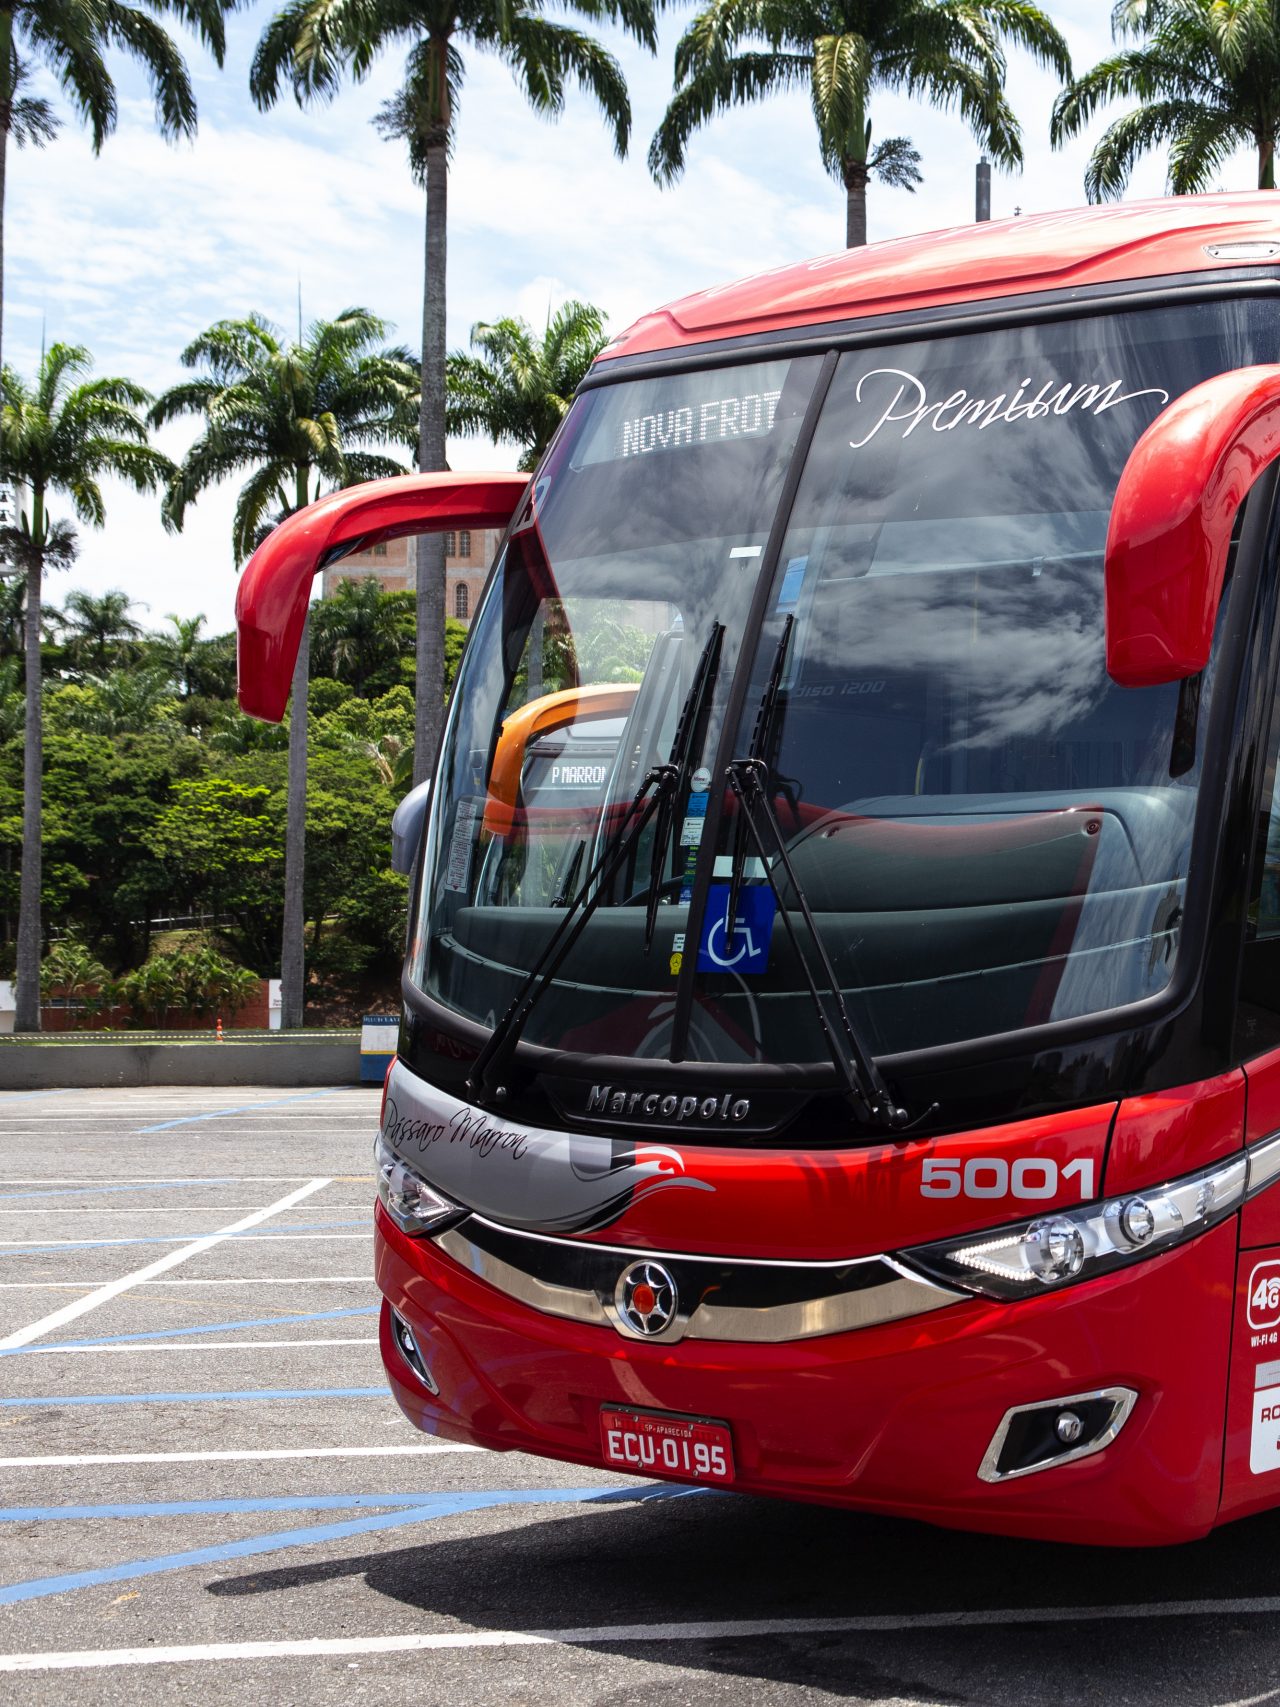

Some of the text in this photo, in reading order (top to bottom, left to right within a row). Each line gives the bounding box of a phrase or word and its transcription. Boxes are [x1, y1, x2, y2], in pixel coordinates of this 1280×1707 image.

[850, 368, 1168, 448] Premium
[623, 407, 692, 457] NOVA
[551, 766, 560, 784] P
[585, 1085, 750, 1121] Marcopolo
[384, 1097, 528, 1160] Pássaro Marron
[919, 1157, 1095, 1200] 5001
[1250, 1332, 1278, 1348] WI-FI 4G
